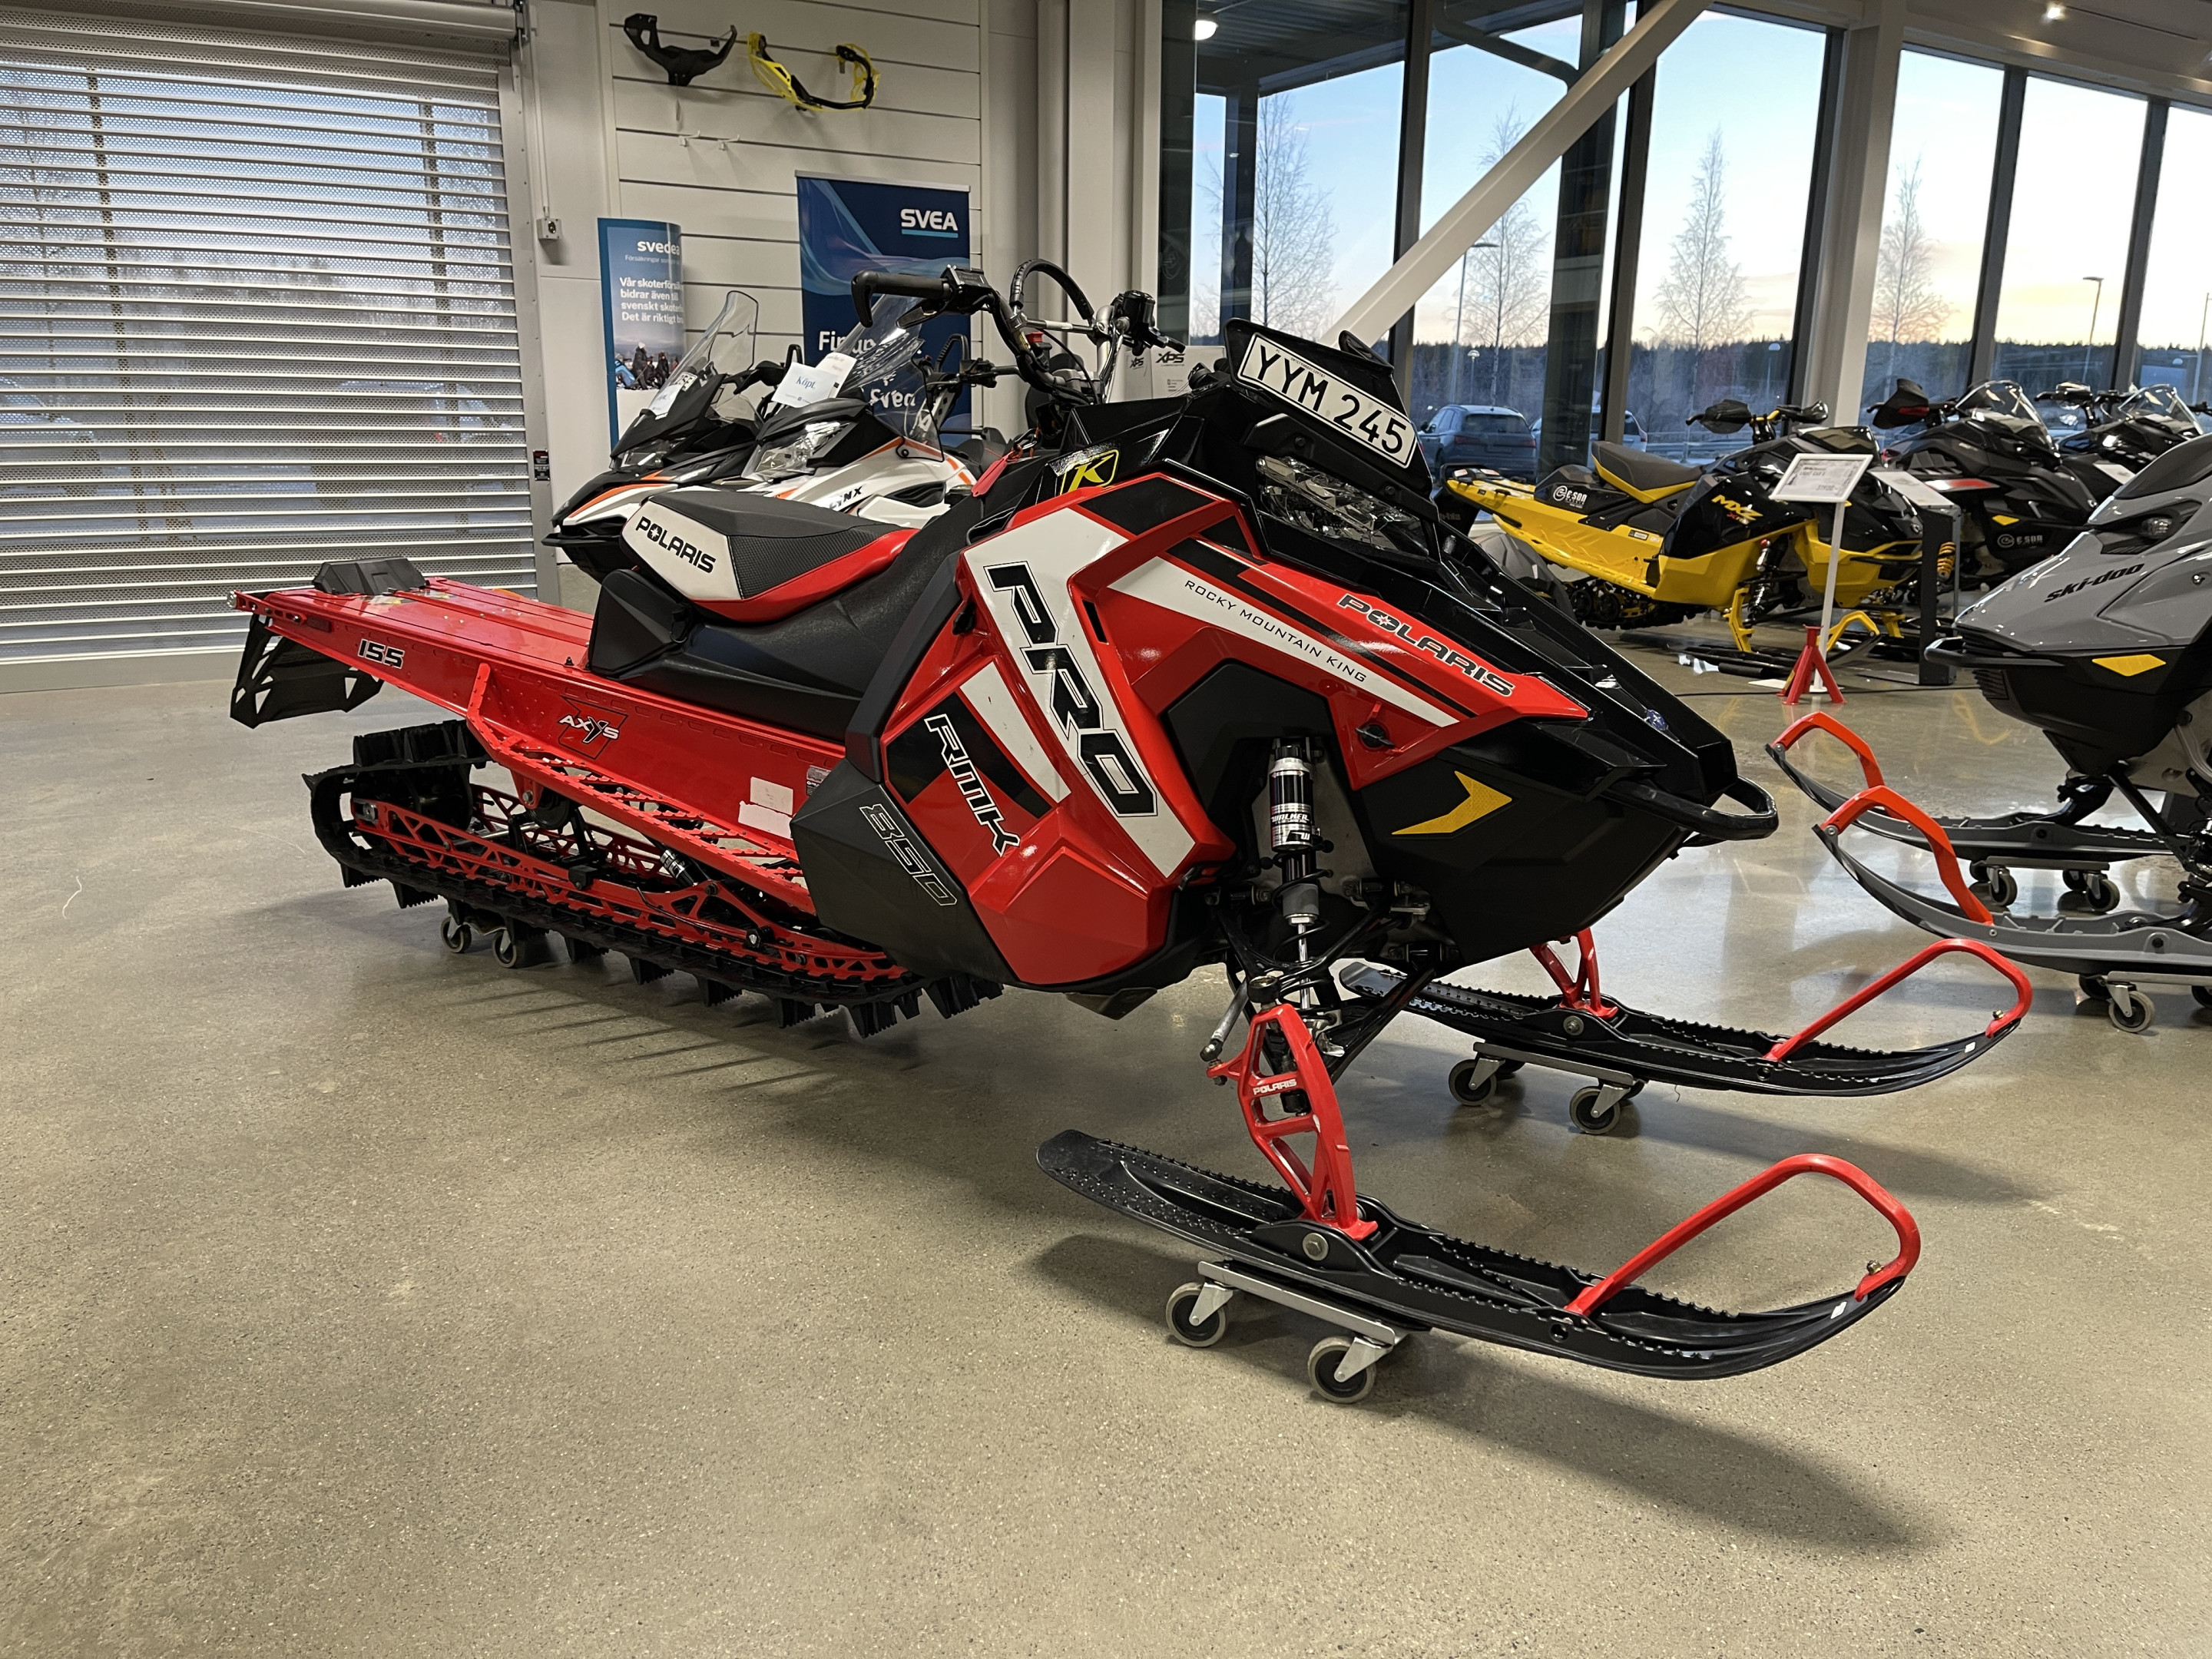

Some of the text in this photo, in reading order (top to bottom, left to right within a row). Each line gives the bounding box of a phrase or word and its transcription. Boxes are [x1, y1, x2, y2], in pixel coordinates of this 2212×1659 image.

[900, 208, 959, 230] SVEA
[637, 240, 680, 255] svedea
[619, 276, 637, 286] Vår
[620, 289, 650, 299] bidrar
[651, 290, 670, 300] även
[621, 301, 658, 311] svenskt
[621, 311, 640, 321] Det
[641, 312, 651, 322] är
[653, 314, 676, 325] riktigt
[1155, 350, 1186, 363] XPS
[1257, 344, 1407, 454] YYM 245
[1711, 494, 1764, 521] MXZ
[635, 516, 717, 574] POLARIS
[2044, 563, 2145, 603] ski-doo
[1184, 580, 1367, 683] ROCKY MOUNTAIN KING
[1336, 593, 1516, 697] POLARIS
[357, 637, 406, 670] 155
[982, 561, 1158, 818] PRO
[558, 714, 620, 743] AXYS
[923, 713, 1021, 857] RMK
[859, 803, 958, 906] 850
[1252, 1078, 1297, 1095] POLARIS
